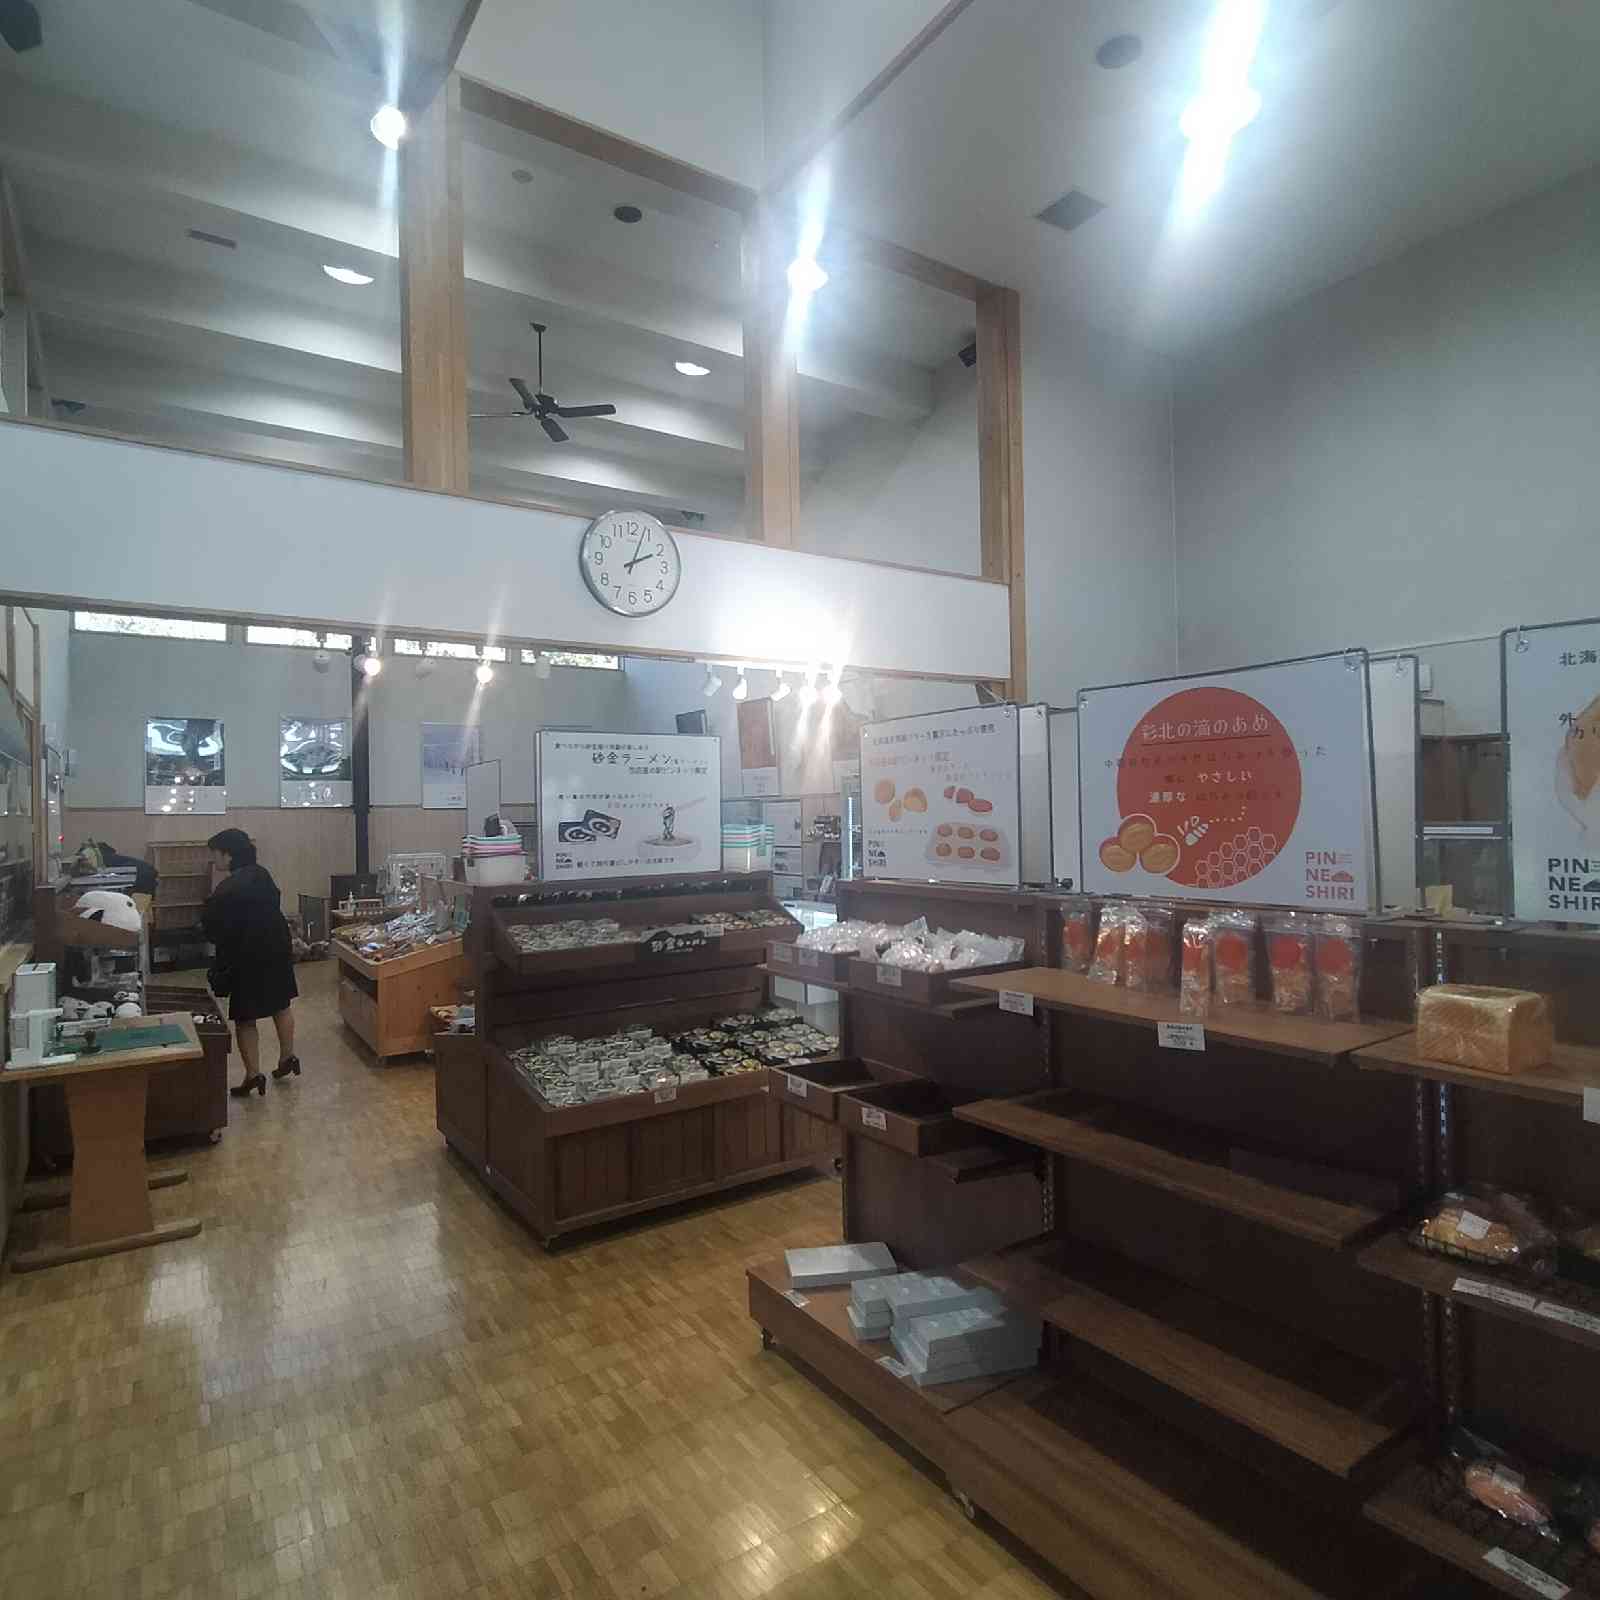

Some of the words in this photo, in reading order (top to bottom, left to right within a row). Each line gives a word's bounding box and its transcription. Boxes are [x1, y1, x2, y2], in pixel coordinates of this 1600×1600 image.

[612, 524, 623, 538] 11
[627, 521, 639, 536] 12
[600, 534, 612, 549] 10
[656, 543, 664, 557] 2
[594, 551, 603, 565] 9
[660, 560, 668, 574] 3
[600, 572, 609, 586] 8
[656, 579, 664, 592] 4
[614, 585, 622, 599] 7
[628, 591, 638, 605] 6
[643, 589, 653, 604] 5
[1559, 649, 1600, 666] 北海
[592, 751, 672, 766] 砂金ラーメン
[1197, 770, 1252, 784] やさしい
[1305, 851, 1337, 865] PIN
[1547, 858, 1590, 874] PIN
[1305, 868, 1330, 882] NE
[1548, 876, 1581, 892] NE
[1305, 885, 1354, 900] SHIRI
